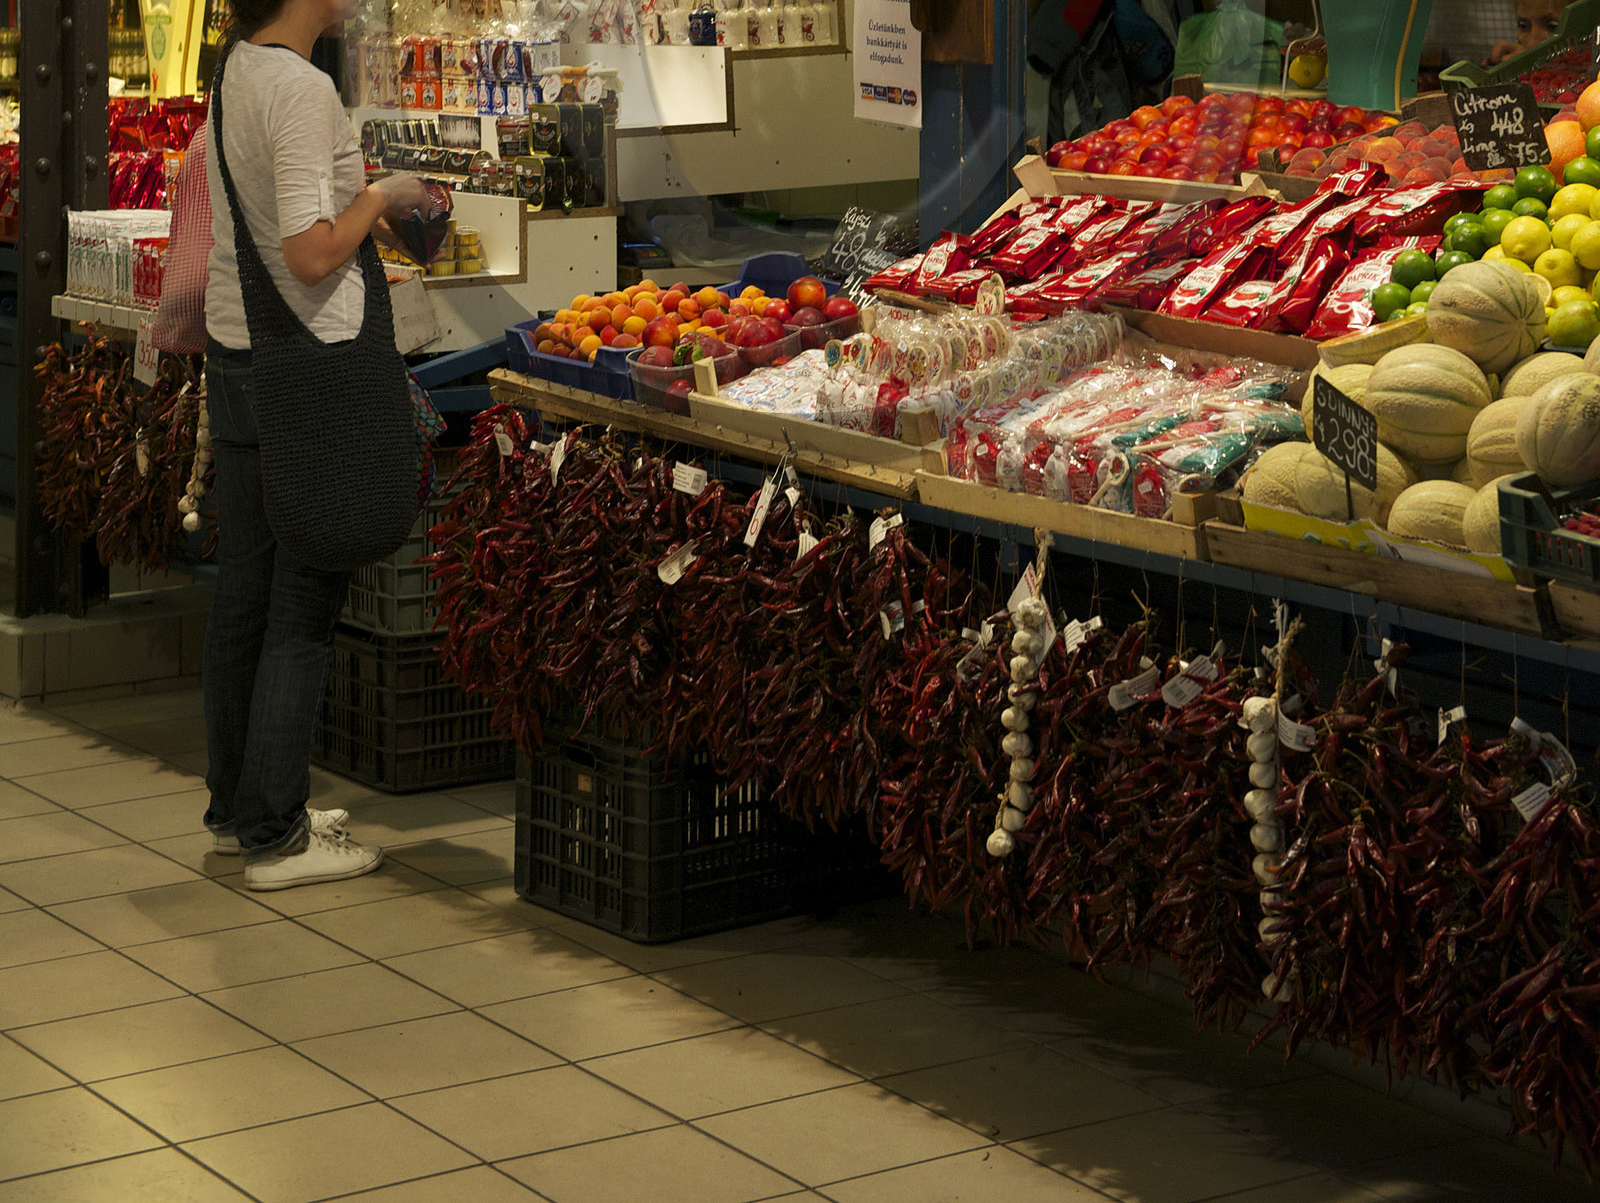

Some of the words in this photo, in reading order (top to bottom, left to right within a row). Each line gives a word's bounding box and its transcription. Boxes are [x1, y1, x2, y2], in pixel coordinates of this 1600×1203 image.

[868, 19, 906, 34] Üzletünkben
[869, 51, 904, 65] elfogadunk.
[862, 87, 873, 95] VISA
[1454, 92, 1518, 116] Citrom
[1463, 138, 1500, 154] Lime
